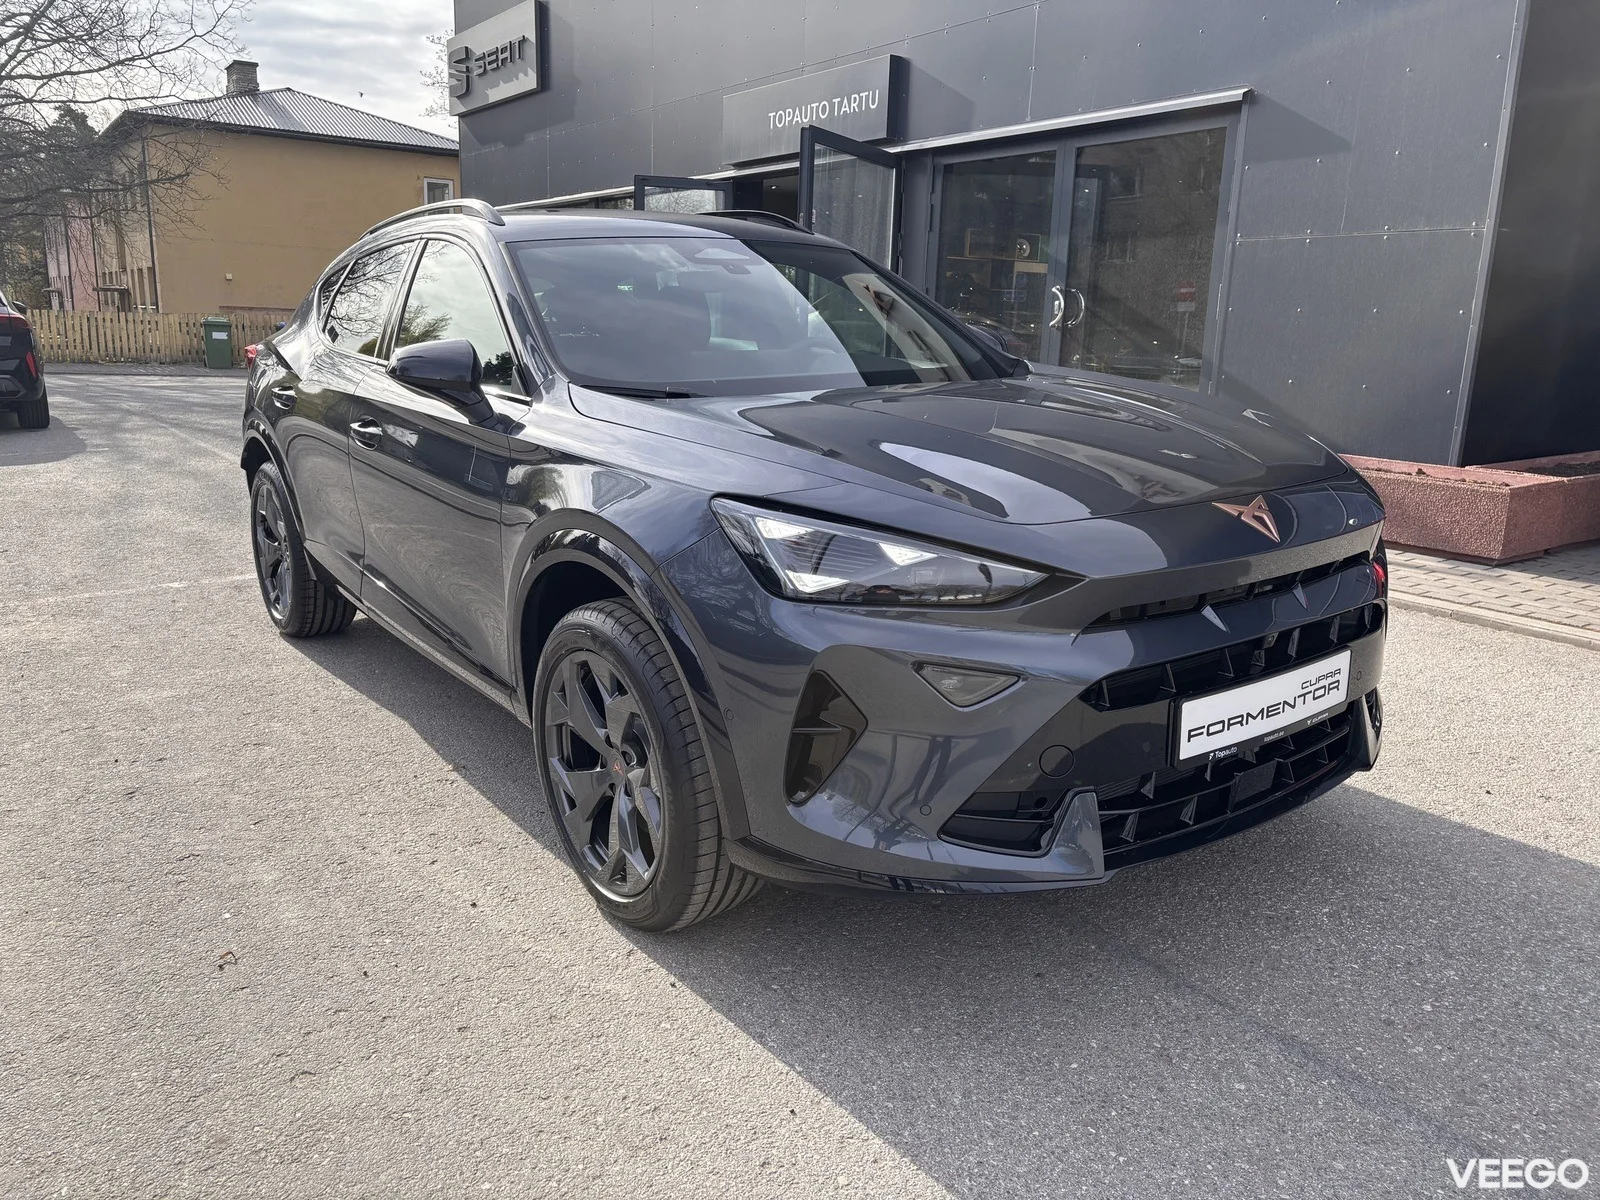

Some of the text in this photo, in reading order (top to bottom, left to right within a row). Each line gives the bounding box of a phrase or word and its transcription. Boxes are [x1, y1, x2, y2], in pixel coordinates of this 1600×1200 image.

[473, 35, 525, 76] SEAT
[768, 89, 879, 130] TOPAUTO TARTU
[1301, 668, 1341, 690] CUPRA
[1187, 679, 1340, 743] FORMENTOR
[1215, 746, 1238, 759] Topauto
